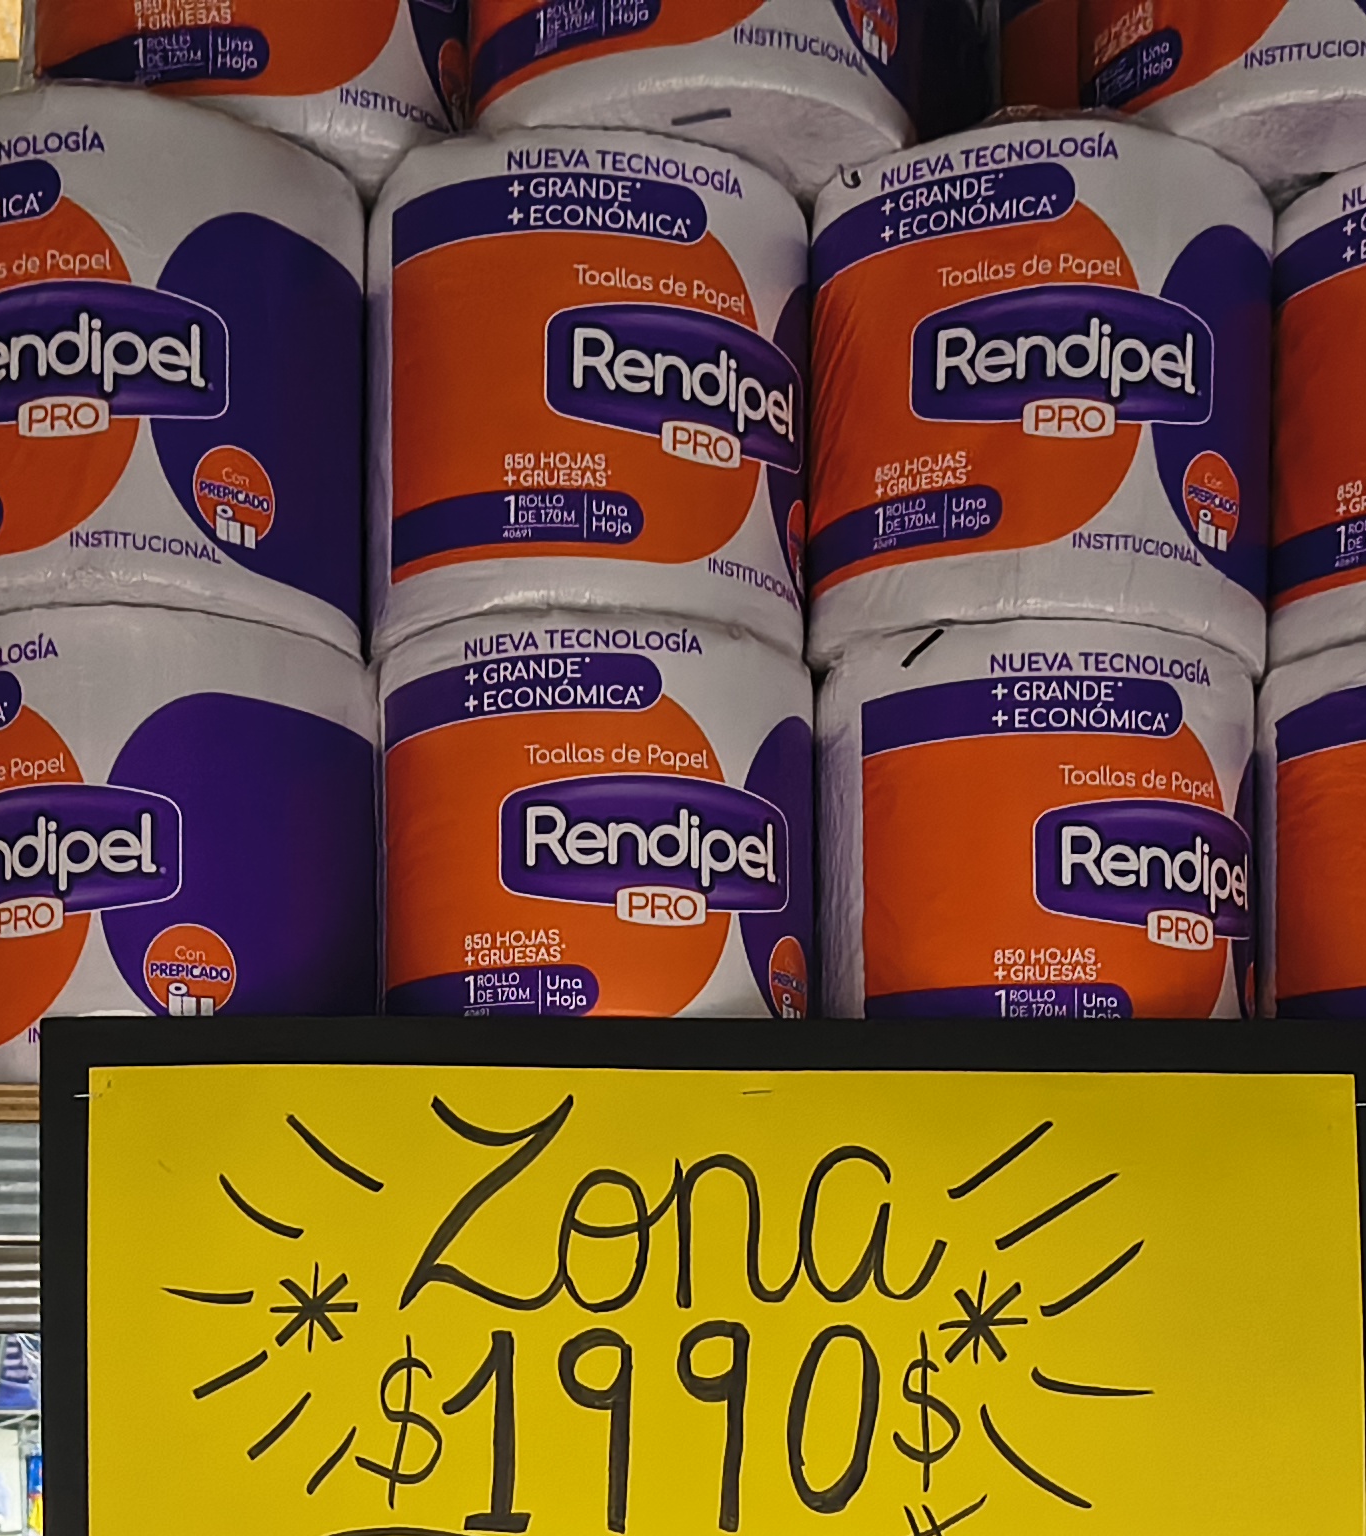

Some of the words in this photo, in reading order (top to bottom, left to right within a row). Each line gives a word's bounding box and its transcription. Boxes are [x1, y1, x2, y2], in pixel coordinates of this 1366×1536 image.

[734, 24, 867, 77] INSTITUCIONAL
[506, 149, 589, 172] NUEVA
[600, 150, 743, 199] TECNOLOGÍA
[880, 154, 955, 192] NUEVA
[961, 131, 1119, 169] TECNOLOGÍA
[573, 264, 653, 292] Toallas
[659, 275, 688, 297] de
[693, 280, 745, 315] Papel
[935, 317, 1196, 398] Rendipel
[572, 326, 795, 442] Rendipel
[26, 403, 100, 432] PRO
[1034, 404, 1106, 433] PRO
[671, 426, 734, 463] PRO
[504, 453, 536, 471] 850
[540, 452, 606, 471] HOJAS
[198, 479, 271, 514] PREPICADO
[518, 493, 565, 507] ROLLO
[592, 499, 628, 516] Una
[518, 509, 537, 524] DE
[592, 516, 632, 537] Hoja
[69, 530, 223, 565] INSTITUCIONAL
[1071, 531, 1202, 567] INSTITUCIONAL
[463, 631, 538, 661] NUEVA
[544, 626, 703, 656] TECNOLOGÍA
[523, 743, 605, 766] Toallas
[611, 743, 641, 764] de
[647, 743, 710, 772] Papel
[525, 805, 776, 887] Rendipel
[1060, 825, 1249, 914] Rendipel
[627, 891, 698, 922] PRO
[464, 932, 492, 951] 850
[495, 928, 561, 947] HOJAS
[1156, 914, 1208, 945] PRO
[174, 945, 207, 962] Con
[149, 962, 232, 983] PREPICADO
[464, 974, 475, 1004] 1
[477, 971, 520, 988] ROLLO
[546, 974, 583, 991] Una
[477, 989, 494, 1004] DE
[546, 991, 587, 1010] Hoja
[399, 1094, 949, 1314] Zona
